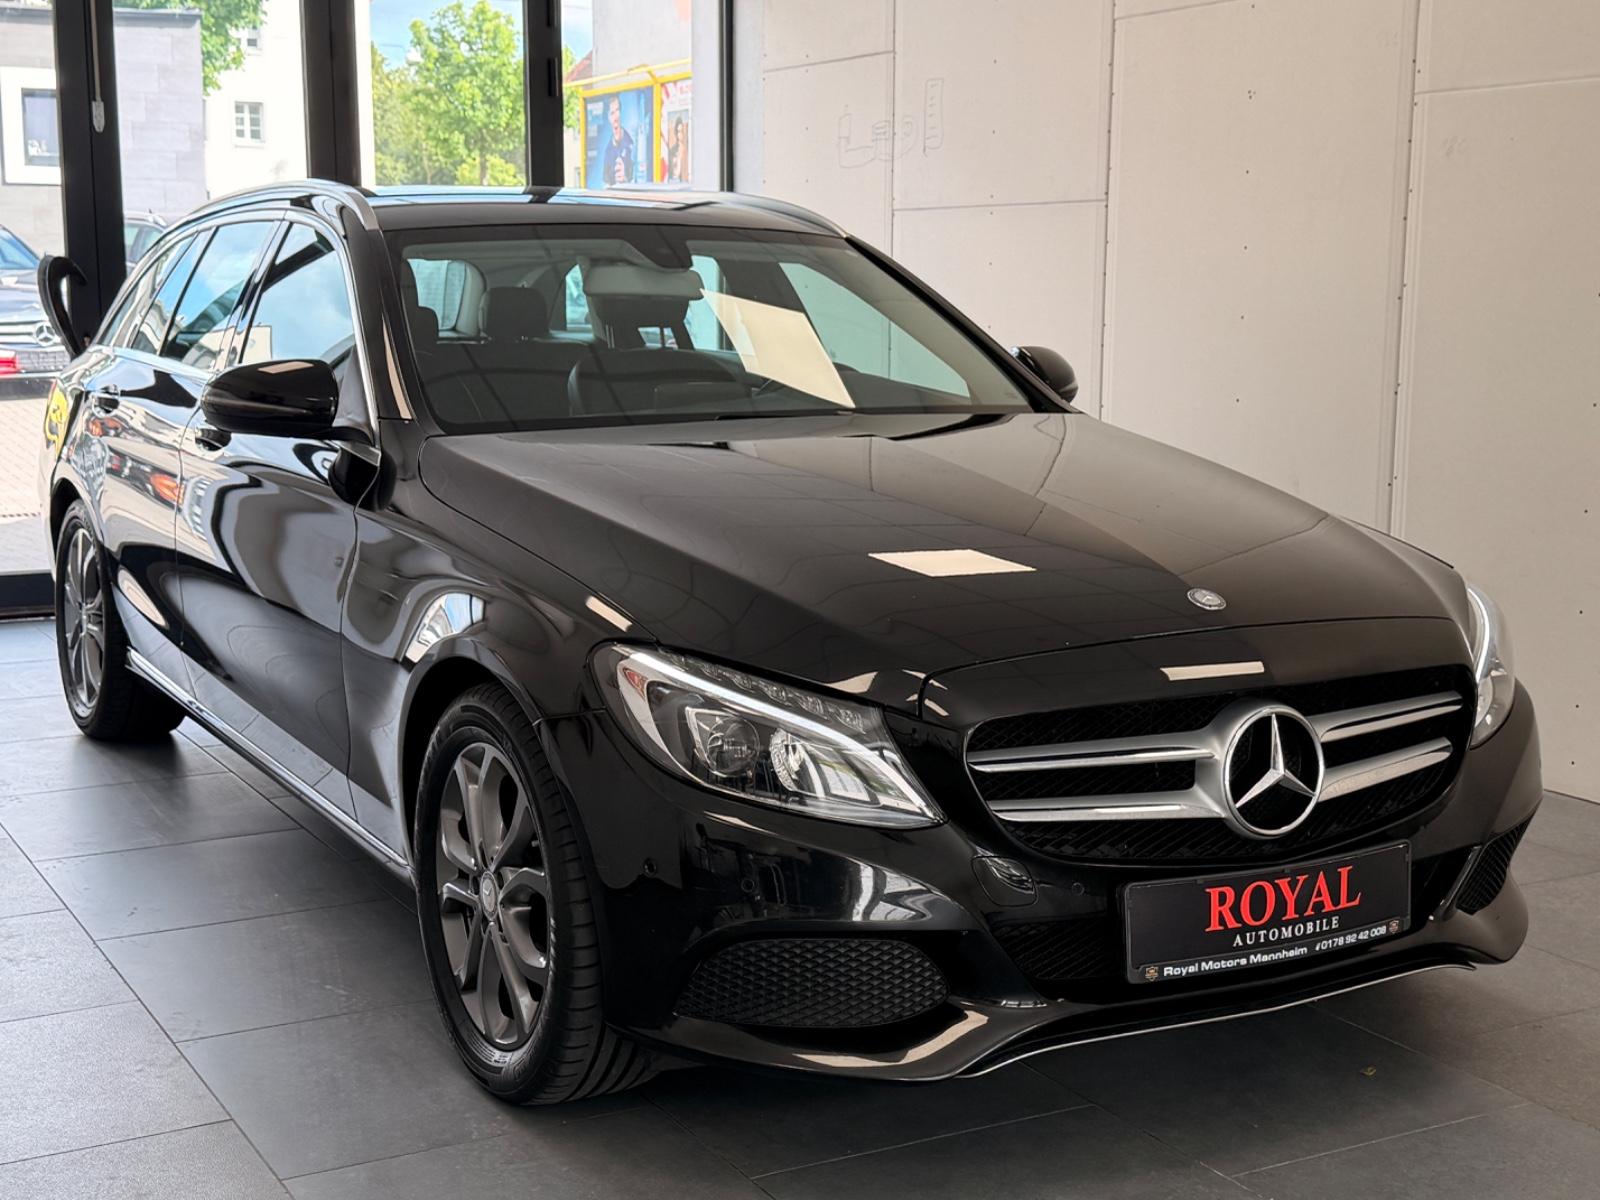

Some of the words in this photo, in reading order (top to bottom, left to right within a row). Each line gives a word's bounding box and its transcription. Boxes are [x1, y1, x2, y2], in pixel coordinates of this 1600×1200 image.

[1205, 865, 1362, 932] ROYAL
[1232, 916, 1340, 948] AUTOMOBILE
[1163, 963, 1199, 977] Royal
[1200, 957, 1248, 972] Motors
[1249, 947, 1308, 964] Mannheim
